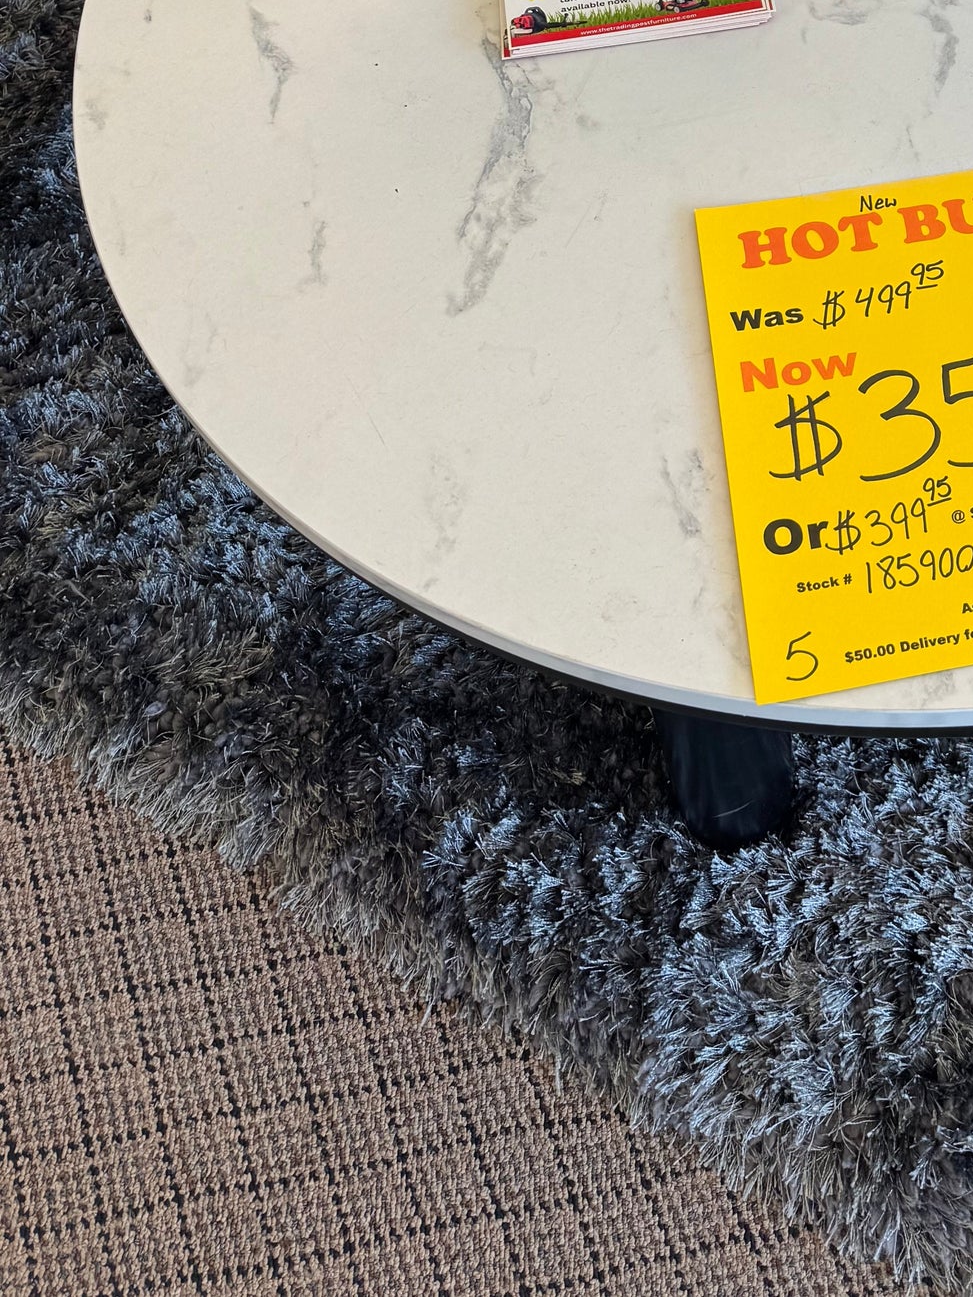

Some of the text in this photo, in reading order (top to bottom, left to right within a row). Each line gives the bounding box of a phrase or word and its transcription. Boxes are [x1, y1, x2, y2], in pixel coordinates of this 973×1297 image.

[560, 0, 606, 15] available
[859, 194, 897, 213] New
[737, 214, 884, 270] HOT
[729, 307, 804, 332] Was
[739, 352, 857, 393] Now
[763, 518, 829, 556] Or
[796, 576, 840, 593] Stock
[786, 631, 819, 682] 5
[844, 643, 896, 664] $50.00
[899, 633, 960, 653] Delivery
